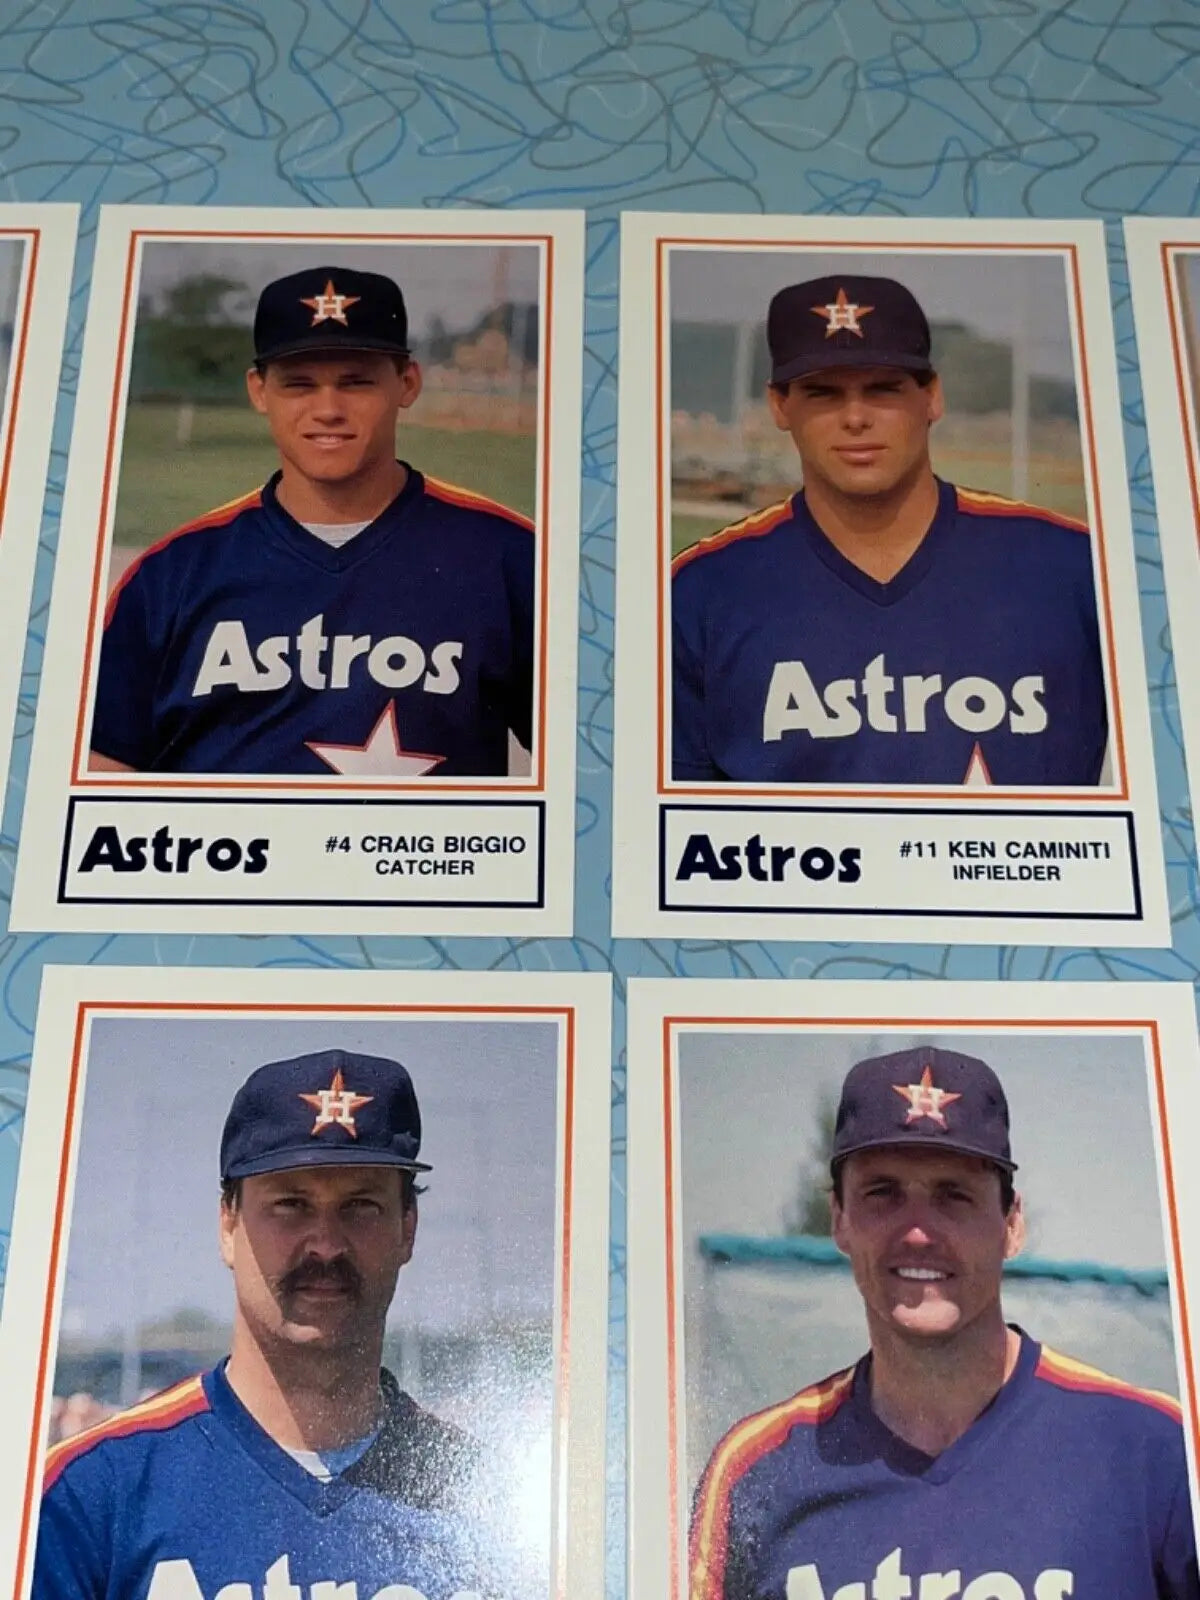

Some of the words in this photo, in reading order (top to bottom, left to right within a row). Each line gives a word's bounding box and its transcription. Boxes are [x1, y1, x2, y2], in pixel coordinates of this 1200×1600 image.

[314, 295, 346, 319] H
[825, 304, 860, 329] H
[191, 613, 463, 697] Astros
[763, 653, 1048, 743] Astros
[77, 825, 270, 873] Astros
[325, 835, 351, 853] #4
[360, 835, 435, 854] CRAIG
[443, 835, 526, 854] BIGGIO
[675, 833, 861, 883] Astros
[899, 840, 937, 858] #11
[948, 840, 996, 859] KEN
[1005, 840, 1111, 860] CAMINITI
[375, 859, 475, 876] CATCHER
[953, 864, 1061, 882] INFIELDER
[315, 1090, 356, 1124] H
[907, 1084, 945, 1119] H
